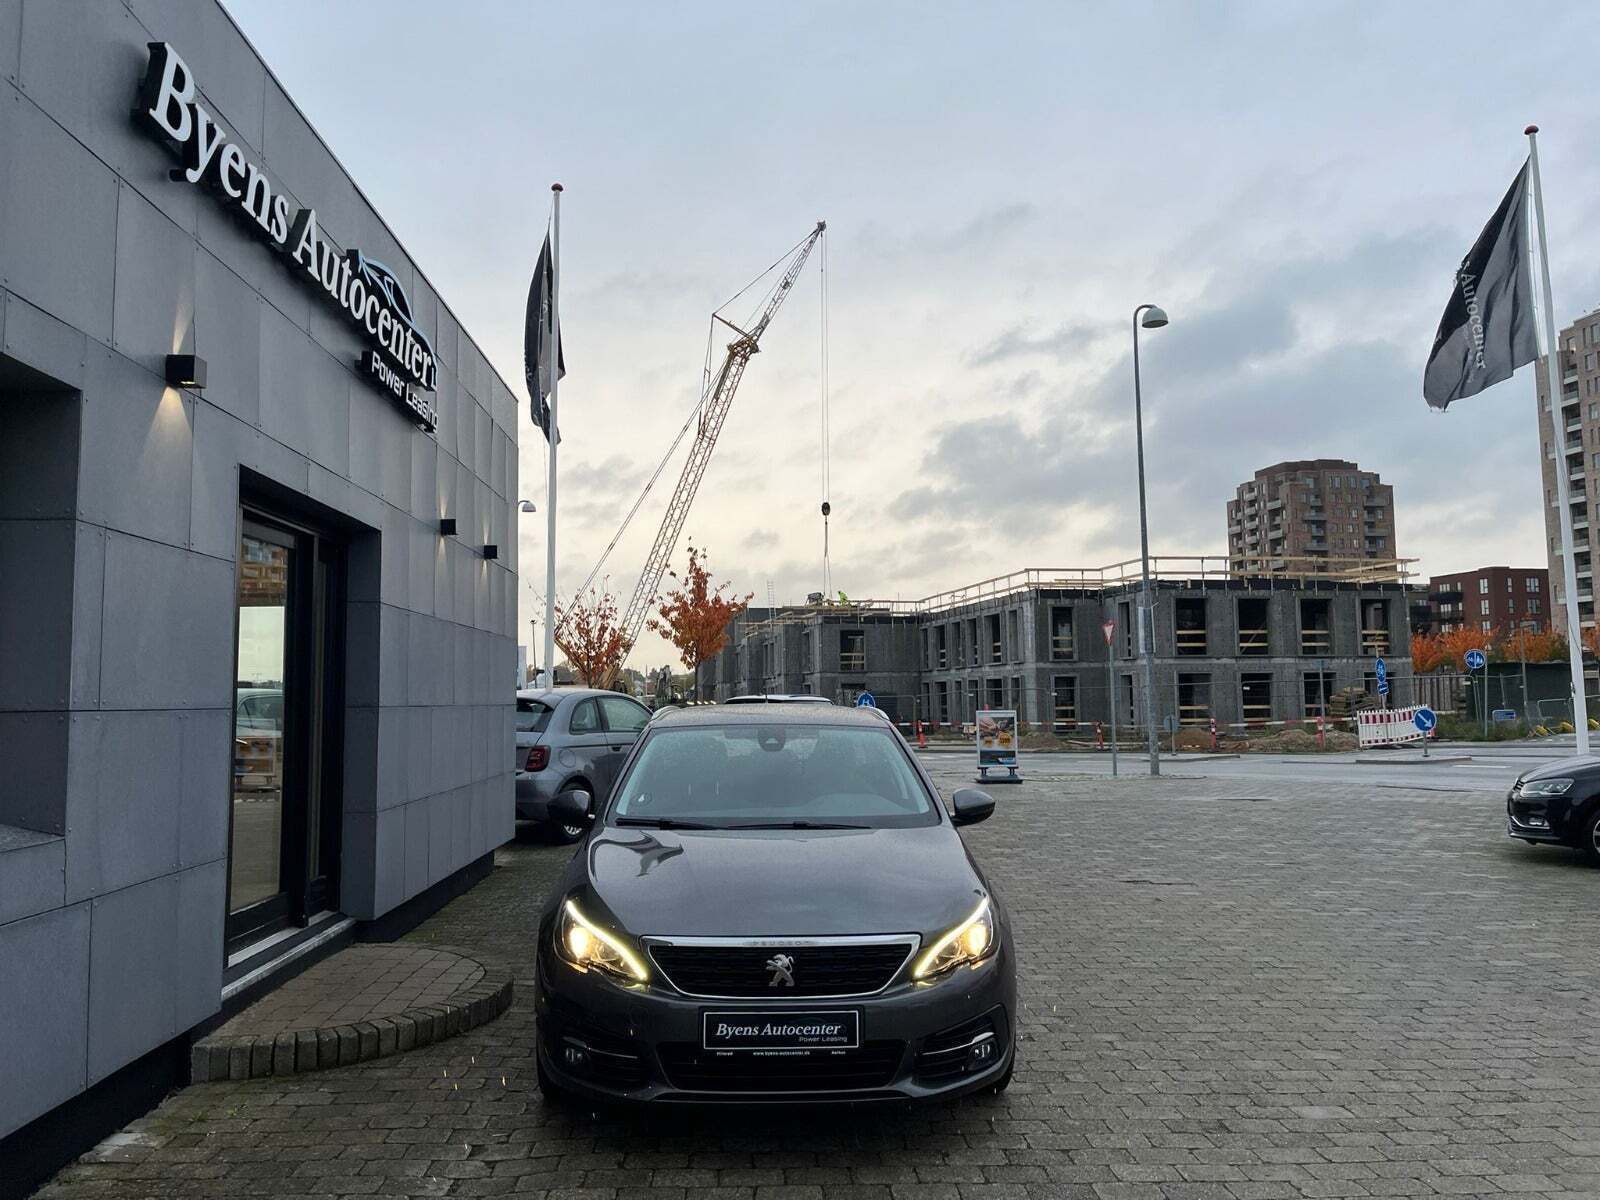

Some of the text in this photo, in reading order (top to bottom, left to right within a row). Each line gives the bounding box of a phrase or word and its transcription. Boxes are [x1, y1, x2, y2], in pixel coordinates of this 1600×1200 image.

[147, 41, 433, 388] Byens Autocenter
[371, 350, 438, 434] Power Leasing
[716, 1023, 842, 1039] Byens Autocenter
